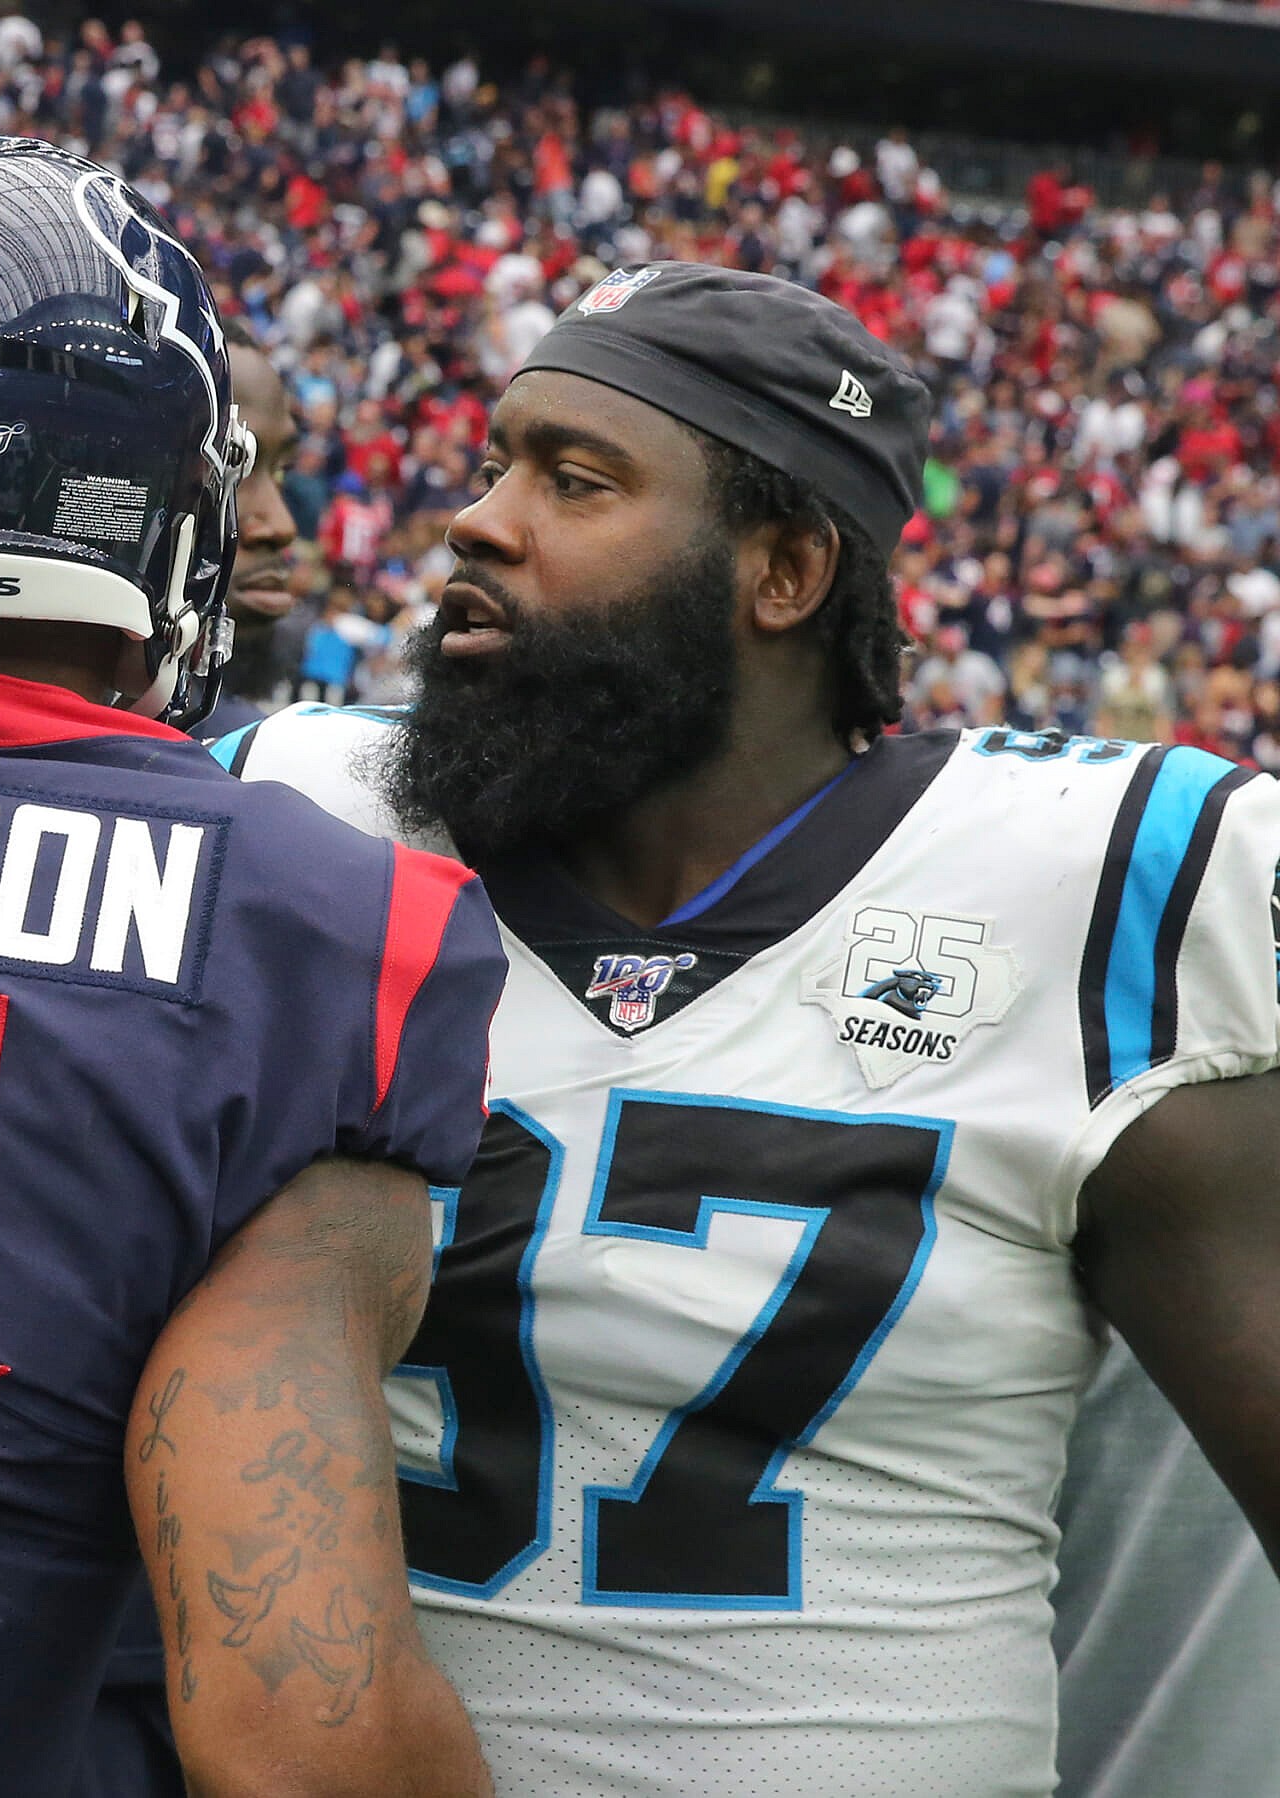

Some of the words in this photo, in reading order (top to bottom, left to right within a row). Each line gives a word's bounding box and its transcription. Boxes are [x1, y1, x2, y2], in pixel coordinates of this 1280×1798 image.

[841, 906, 986, 1018] 25
[618, 1001, 648, 1021] NFL
[839, 1015, 957, 1060] SEASONS
